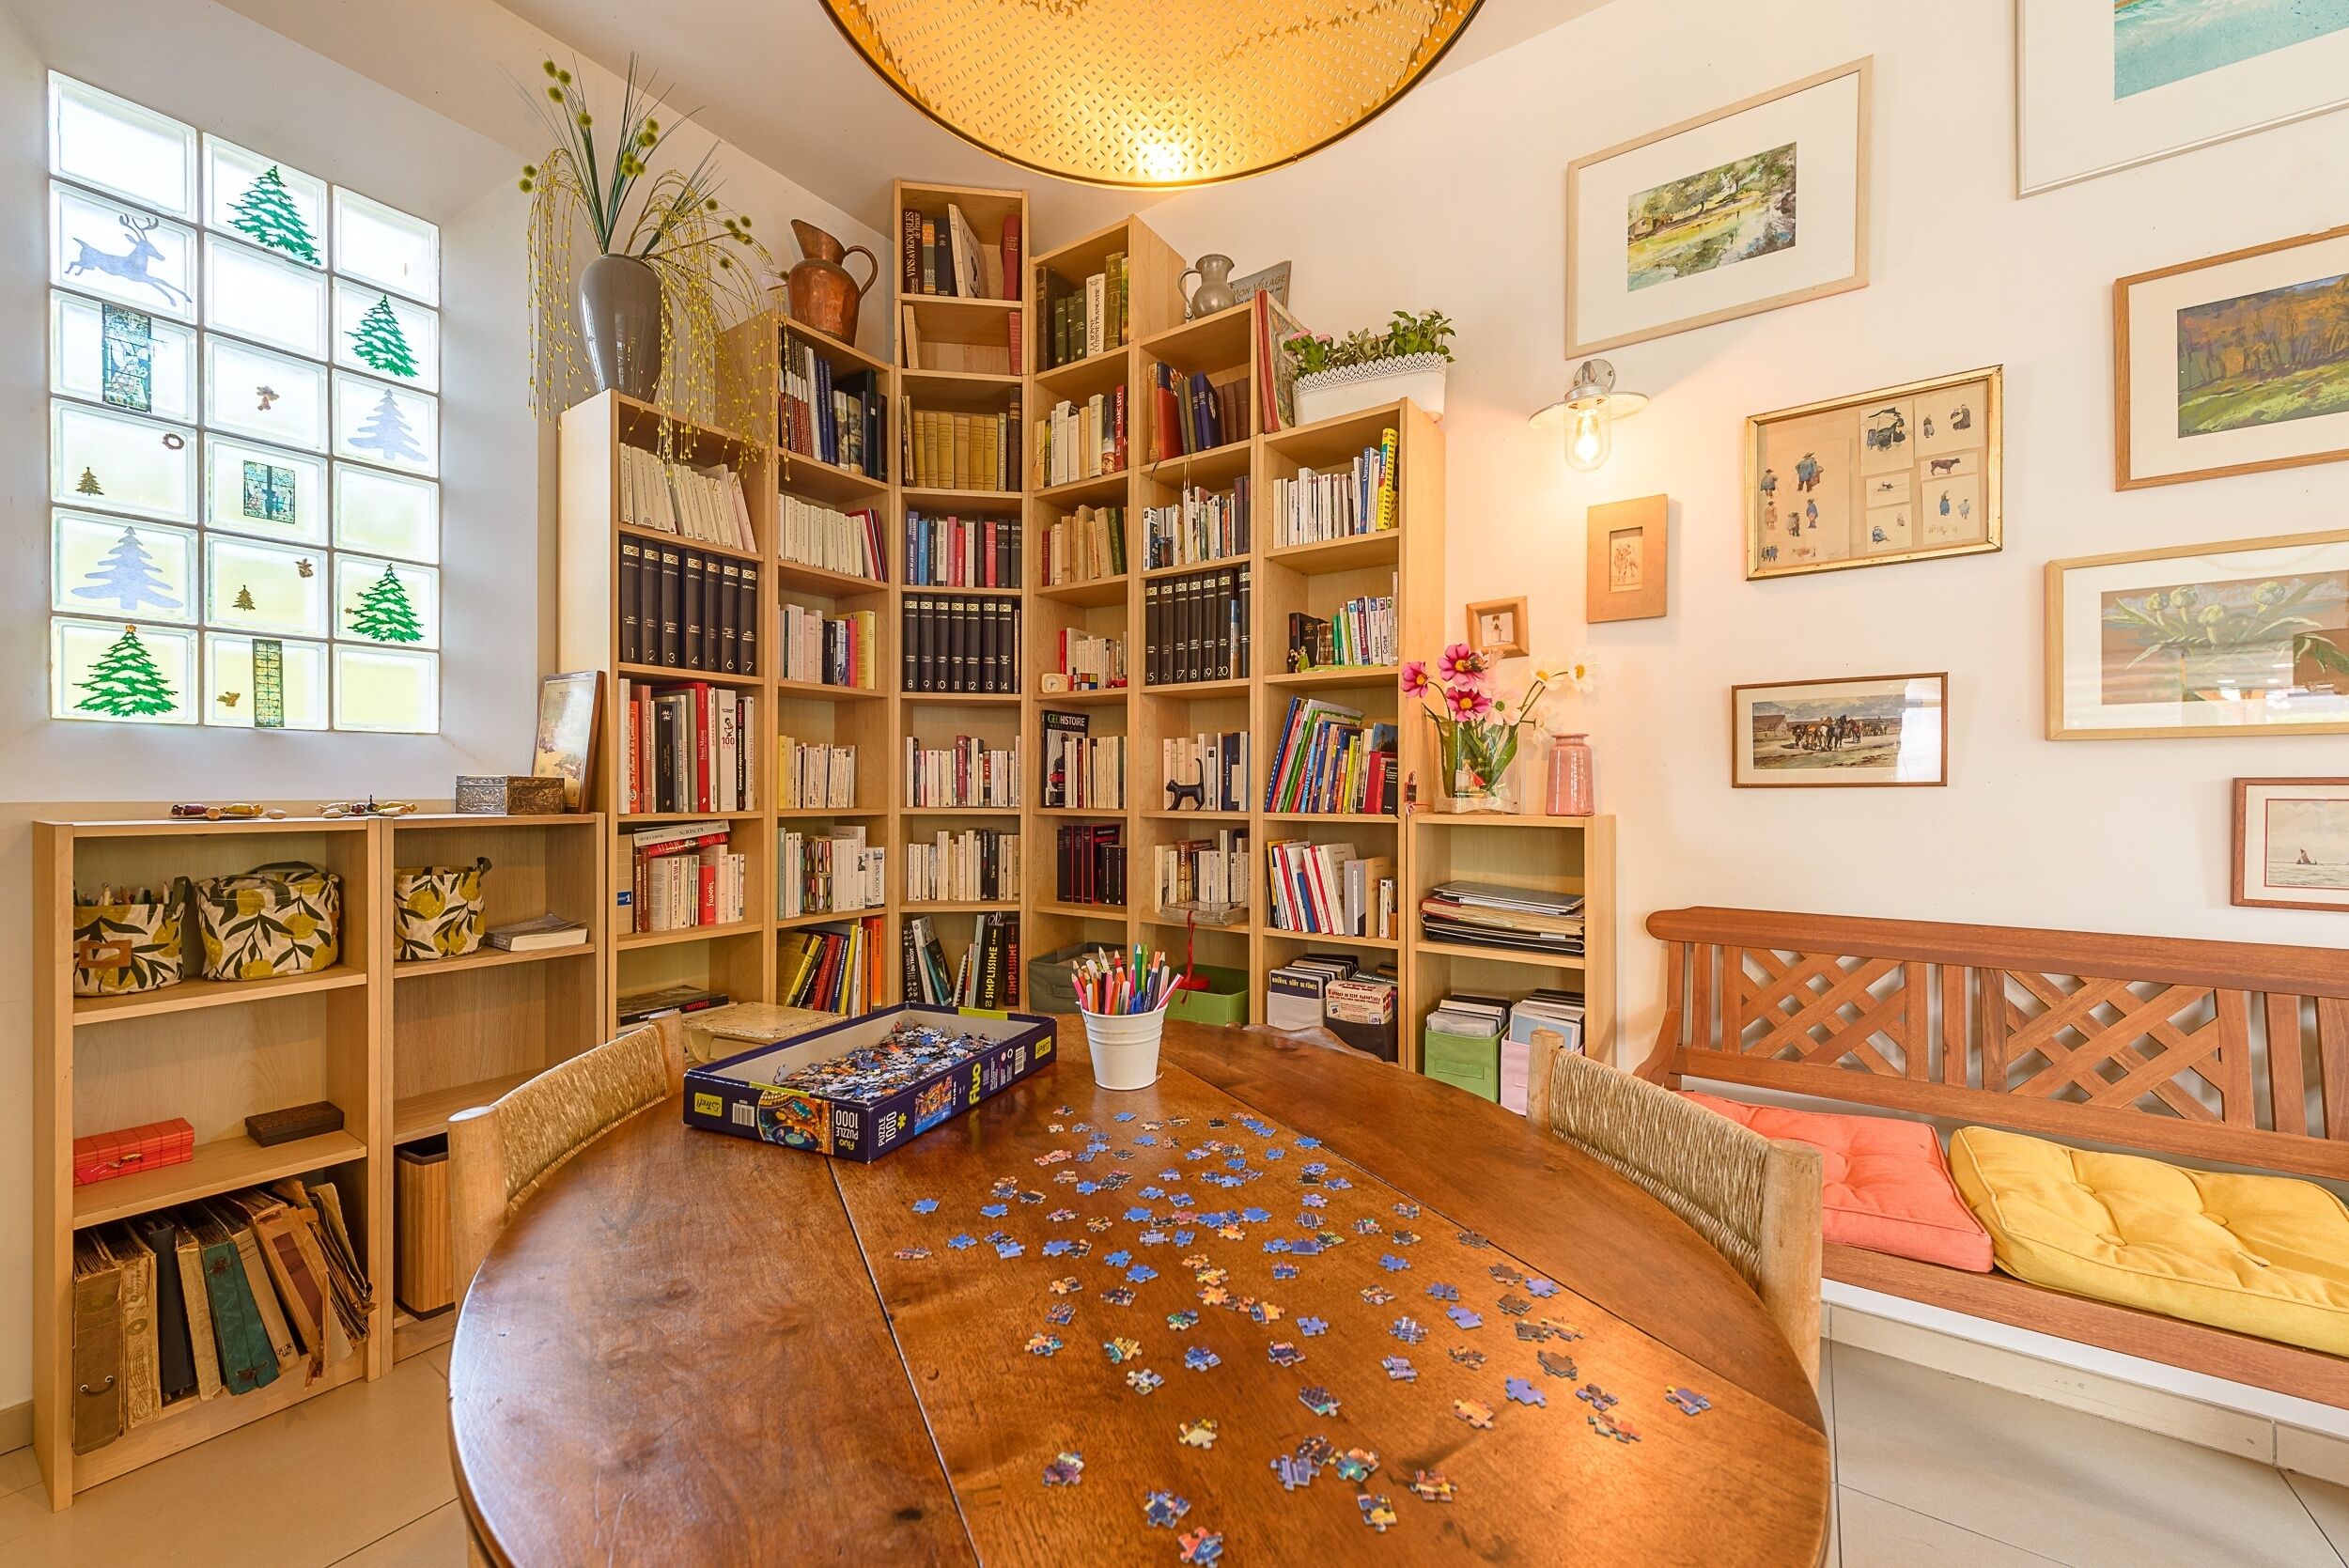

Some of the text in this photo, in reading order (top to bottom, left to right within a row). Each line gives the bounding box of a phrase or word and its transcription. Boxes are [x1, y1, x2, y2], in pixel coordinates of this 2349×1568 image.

[906, 211, 915, 254] VIGNOBLES
[907, 259, 915, 276] VINS
[1361, 450, 1370, 482] Ouessant
[630, 647, 635, 660] 1
[648, 649, 655, 661] 2
[668, 652, 676, 664] 3
[691, 656, 698, 666] 4
[726, 660, 734, 670] 6
[745, 661, 754, 672] 7
[1217, 666, 1229, 676] 20
[1146, 672, 1155, 682] 15
[1176, 669, 1185, 679] 17
[1190, 669, 1197, 678] 18
[1204, 667, 1212, 677] 19
[907, 679, 913, 688] 8
[923, 679, 930, 688] 9
[937, 680, 946, 689] 10
[954, 681, 959, 690] 11
[968, 681, 976, 690] 12
[986, 681, 994, 690] 13
[1000, 681, 1008, 690] 14
[1060, 715, 1086, 727] HISTOIRE
[721, 737, 735, 745] 100
[678, 827, 704, 836] KUNDUN
[985, 946, 998, 999] SIMPLISSIME
[1008, 943, 1017, 995] SIMPLISSIME
[835, 1110, 859, 1128] 1000
[878, 1115, 886, 1147] PUZZLE
[885, 1110, 897, 1143] 1000
[835, 1126, 859, 1141] PUZZLE
